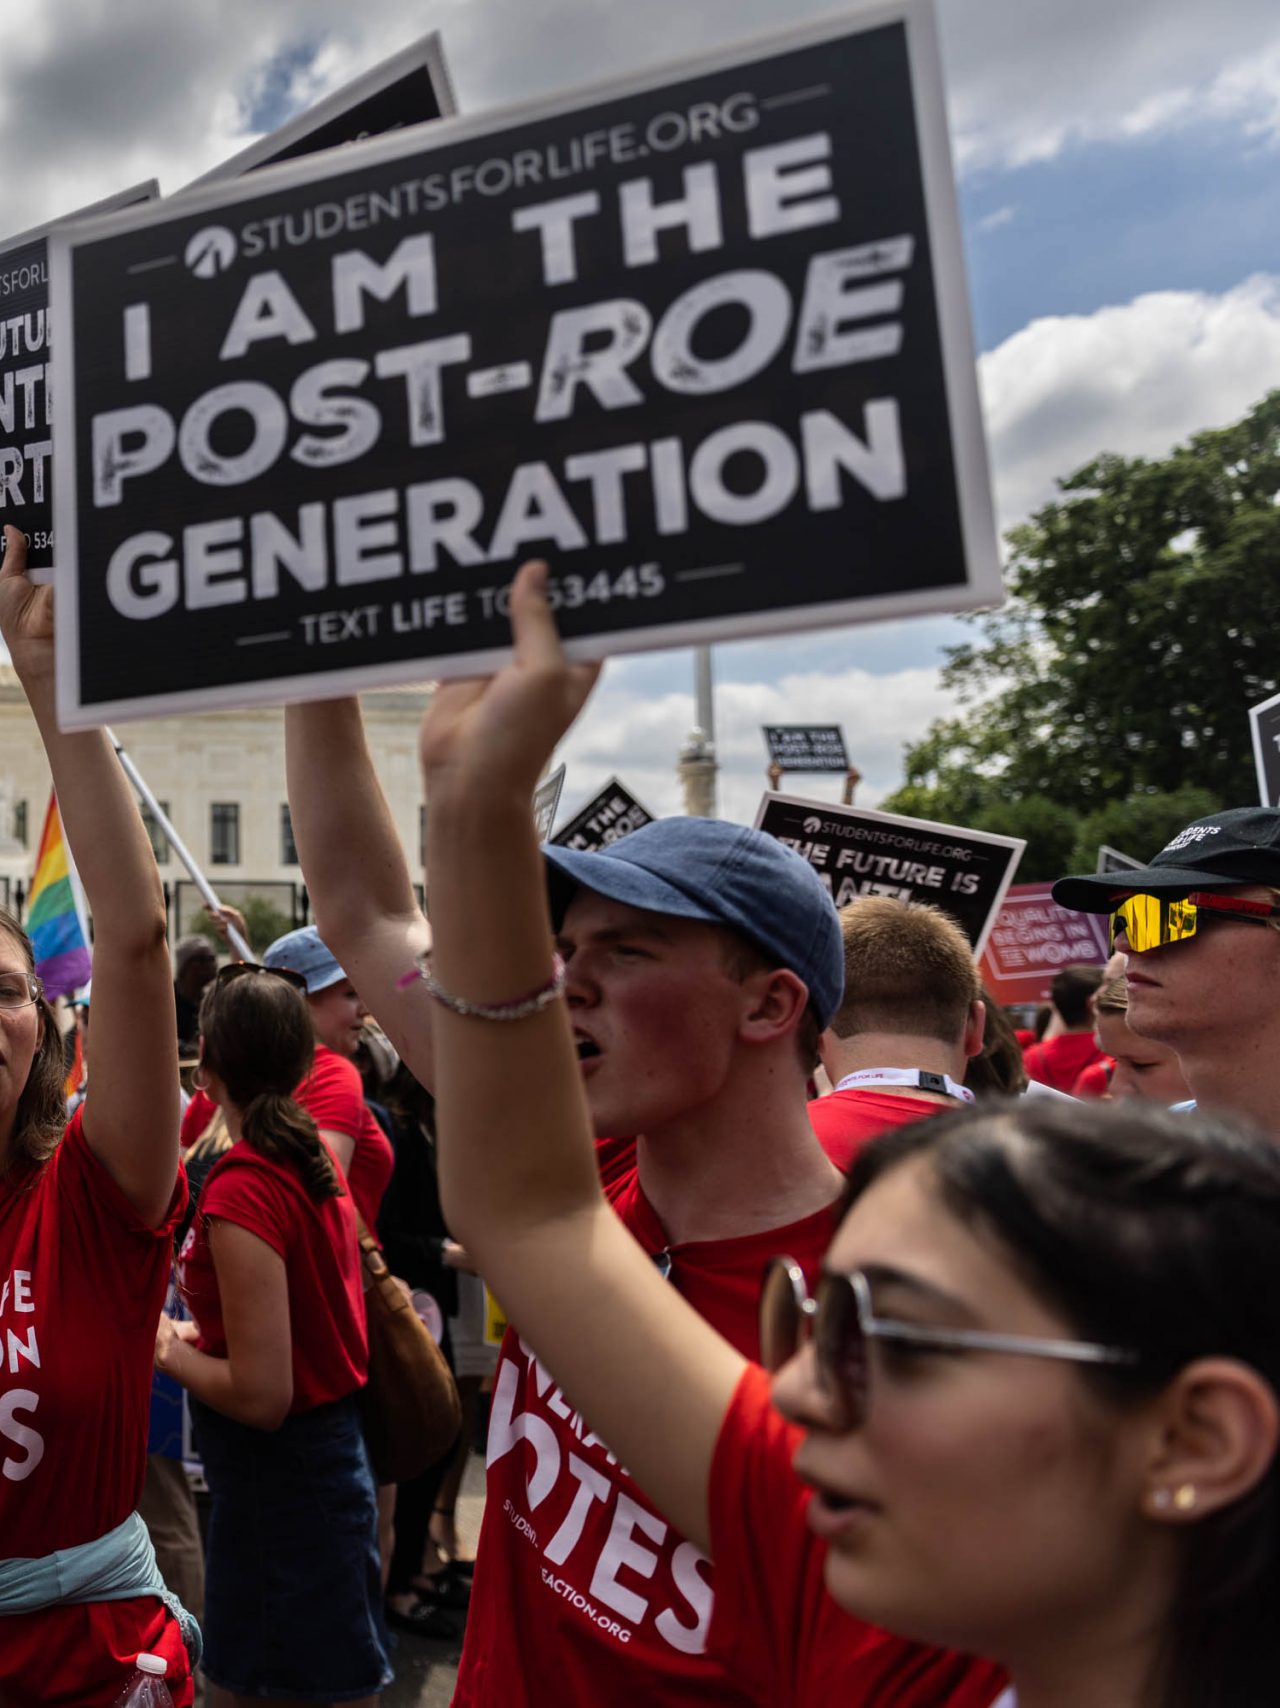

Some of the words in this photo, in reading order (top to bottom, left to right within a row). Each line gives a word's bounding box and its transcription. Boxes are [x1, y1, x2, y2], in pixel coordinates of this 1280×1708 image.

[240, 91, 759, 259] STUDENTSFORLIFE.ORG
[123, 303, 152, 381] I
[220, 233, 438, 361] AM
[513, 132, 841, 286] THE
[92, 234, 914, 508] POST-ROE
[106, 398, 908, 621] GENERATION
[300, 605, 383, 646] TEXT
[390, 593, 468, 634] LIFE
[587, 804, 648, 851] ROE
[821, 821, 972, 862] STUDENTSFORLIFE.ORG
[1180, 826, 1222, 838] DENTS
[836, 848, 946, 889] FUTURE
[950, 872, 982, 895] IS
[991, 923, 1065, 946] BEGINS
[1064, 921, 1091, 939] IN
[1023, 939, 1098, 964] WOMB
[539, 1566, 632, 1643] EACTION.ORG
